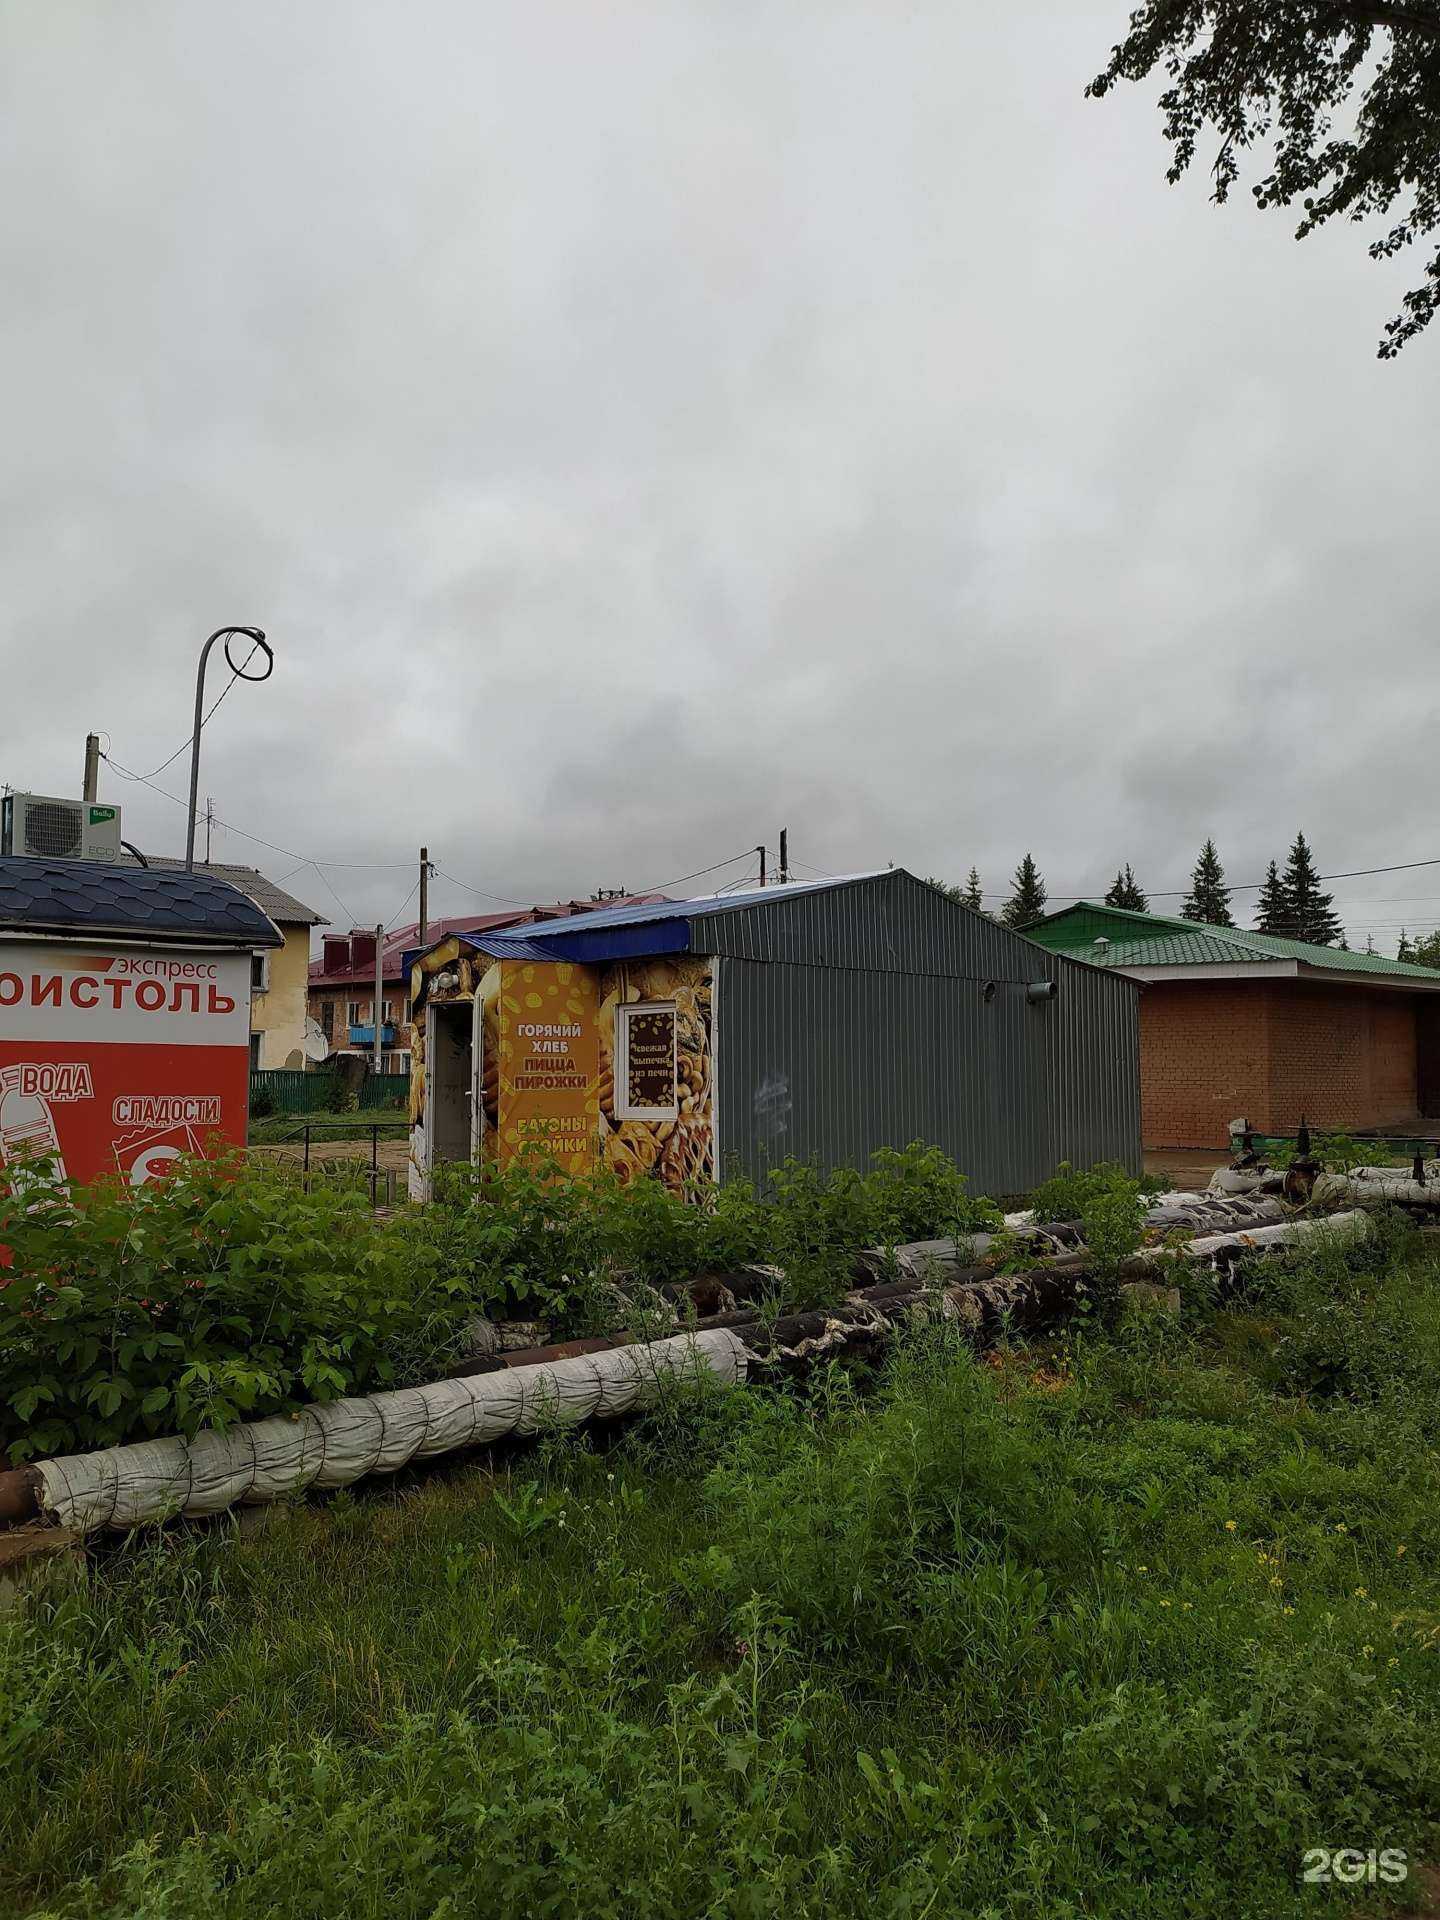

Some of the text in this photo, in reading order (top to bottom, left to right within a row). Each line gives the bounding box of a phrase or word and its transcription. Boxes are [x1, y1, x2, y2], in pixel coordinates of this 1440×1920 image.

[118, 958, 217, 981] экспресс
[518, 1023, 581, 1037] ГОРЯЧИЙ
[532, 1040, 569, 1053] ХЛЕБ
[524, 1057, 576, 1073] ПИЦЦА
[22, 1065, 92, 1100] ВОДА
[514, 1075, 587, 1089] ПИРОЖКИ
[113, 1097, 219, 1126] СЛАДОСТИ
[517, 1117, 588, 1134] БАТОНЫ
